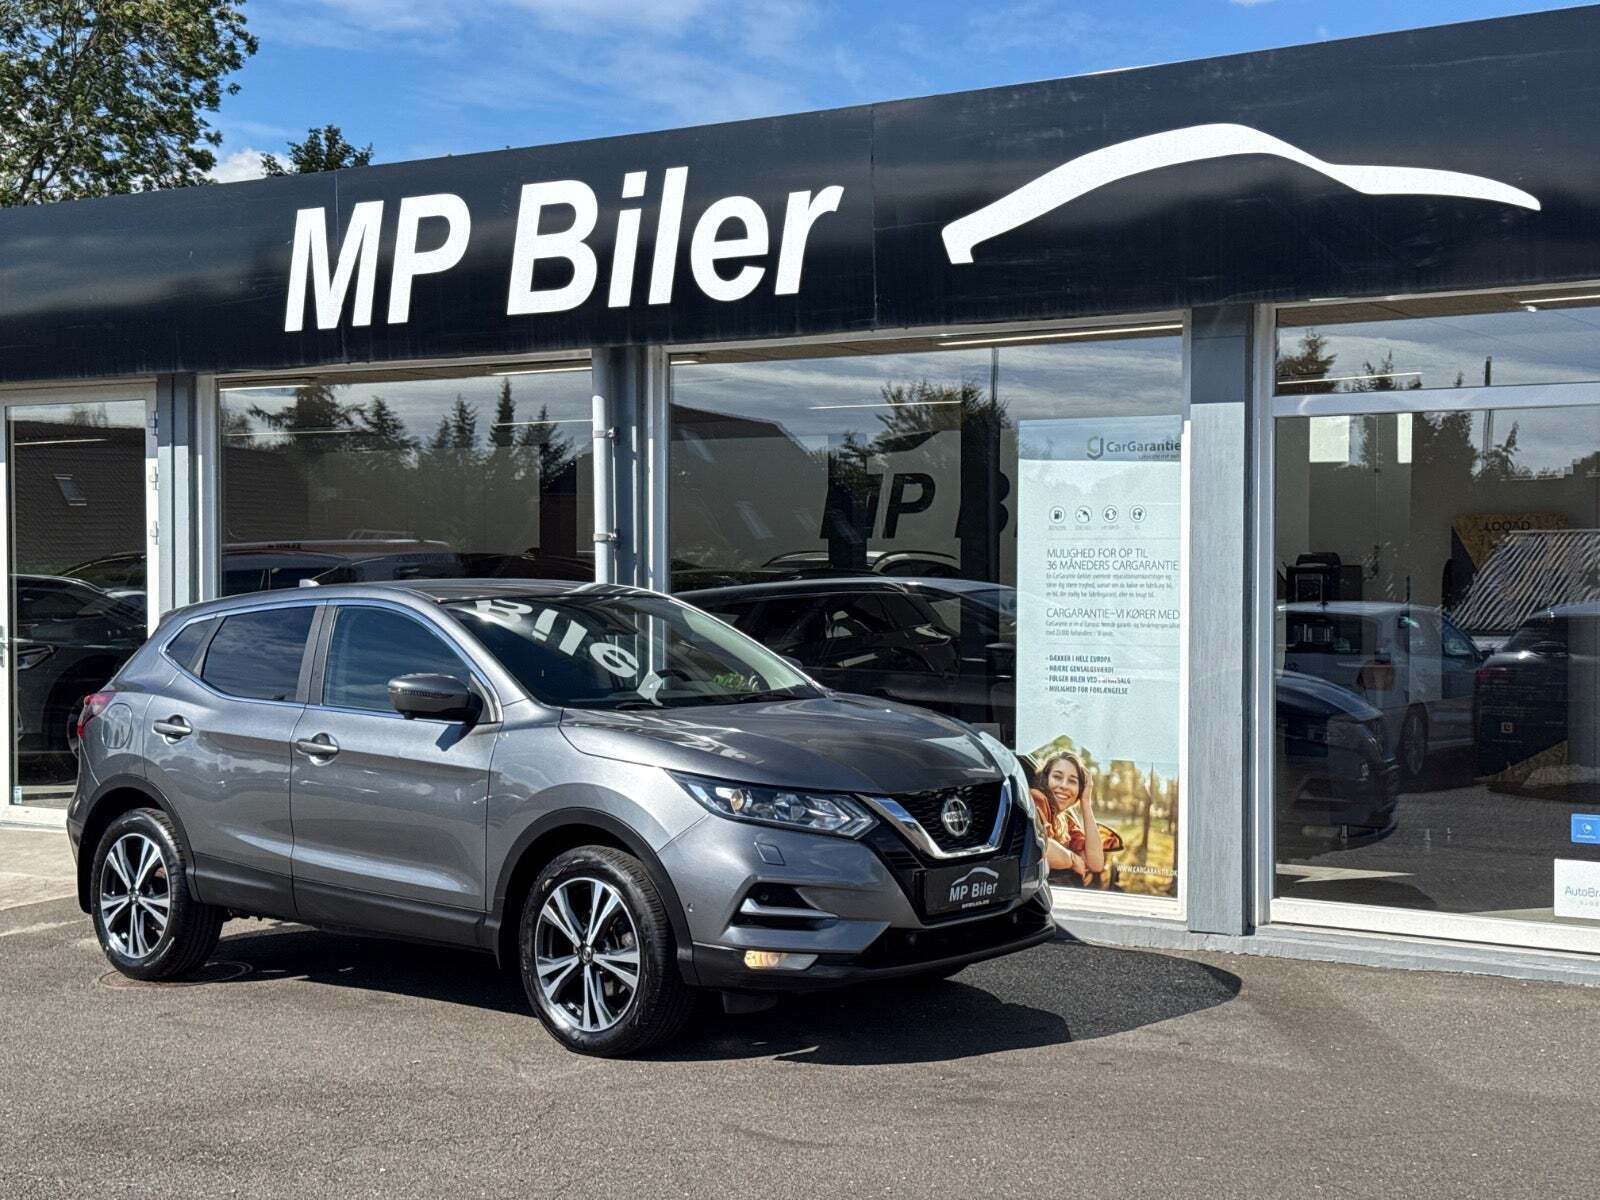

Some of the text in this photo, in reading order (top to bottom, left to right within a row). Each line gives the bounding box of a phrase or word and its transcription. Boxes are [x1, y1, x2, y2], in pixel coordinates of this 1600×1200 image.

[284, 166, 844, 333] MP Biler
[1106, 440, 1181, 453] CarGarantie
[1047, 548, 1149, 559] MULIGHED FOR OP TIL
[1046, 558, 1179, 571] 36 MÅNEDERS CARGARANTIE
[1126, 609, 1156, 619] KØRER
[1157, 609, 1180, 620] MED
[949, 881, 998, 902] MP Biler
[1564, 885, 1600, 898] AutoBr
